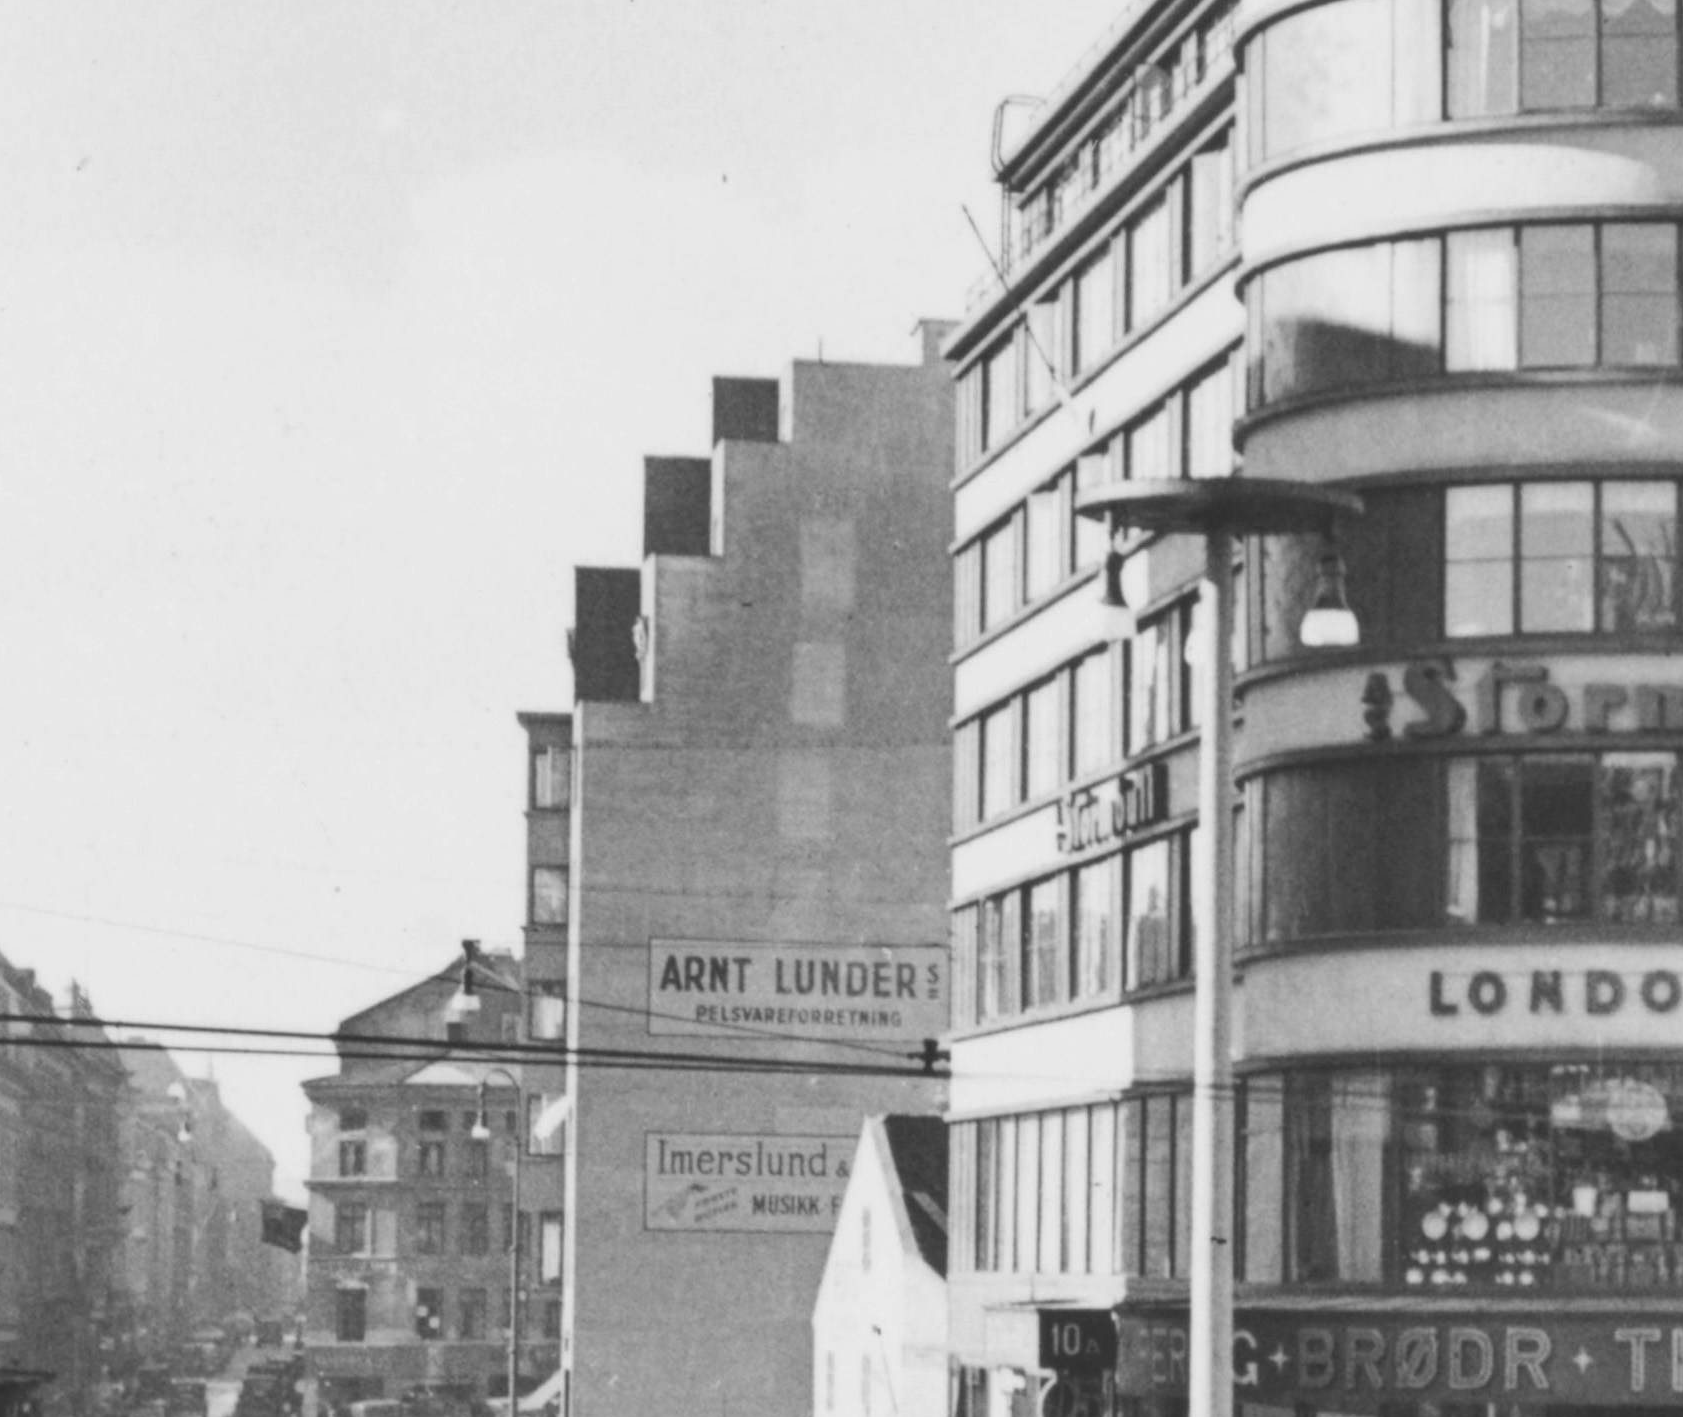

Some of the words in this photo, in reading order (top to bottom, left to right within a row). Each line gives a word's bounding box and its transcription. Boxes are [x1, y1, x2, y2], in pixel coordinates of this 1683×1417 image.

[660, 954, 752, 994] ARNT
[775, 958, 916, 1000] LUNDER
[696, 1004, 903, 1028] PELSVAREFORRETNING
[658, 1138, 827, 1178] Imerslund
[1297, 1325, 1553, 1391] BRØDR
